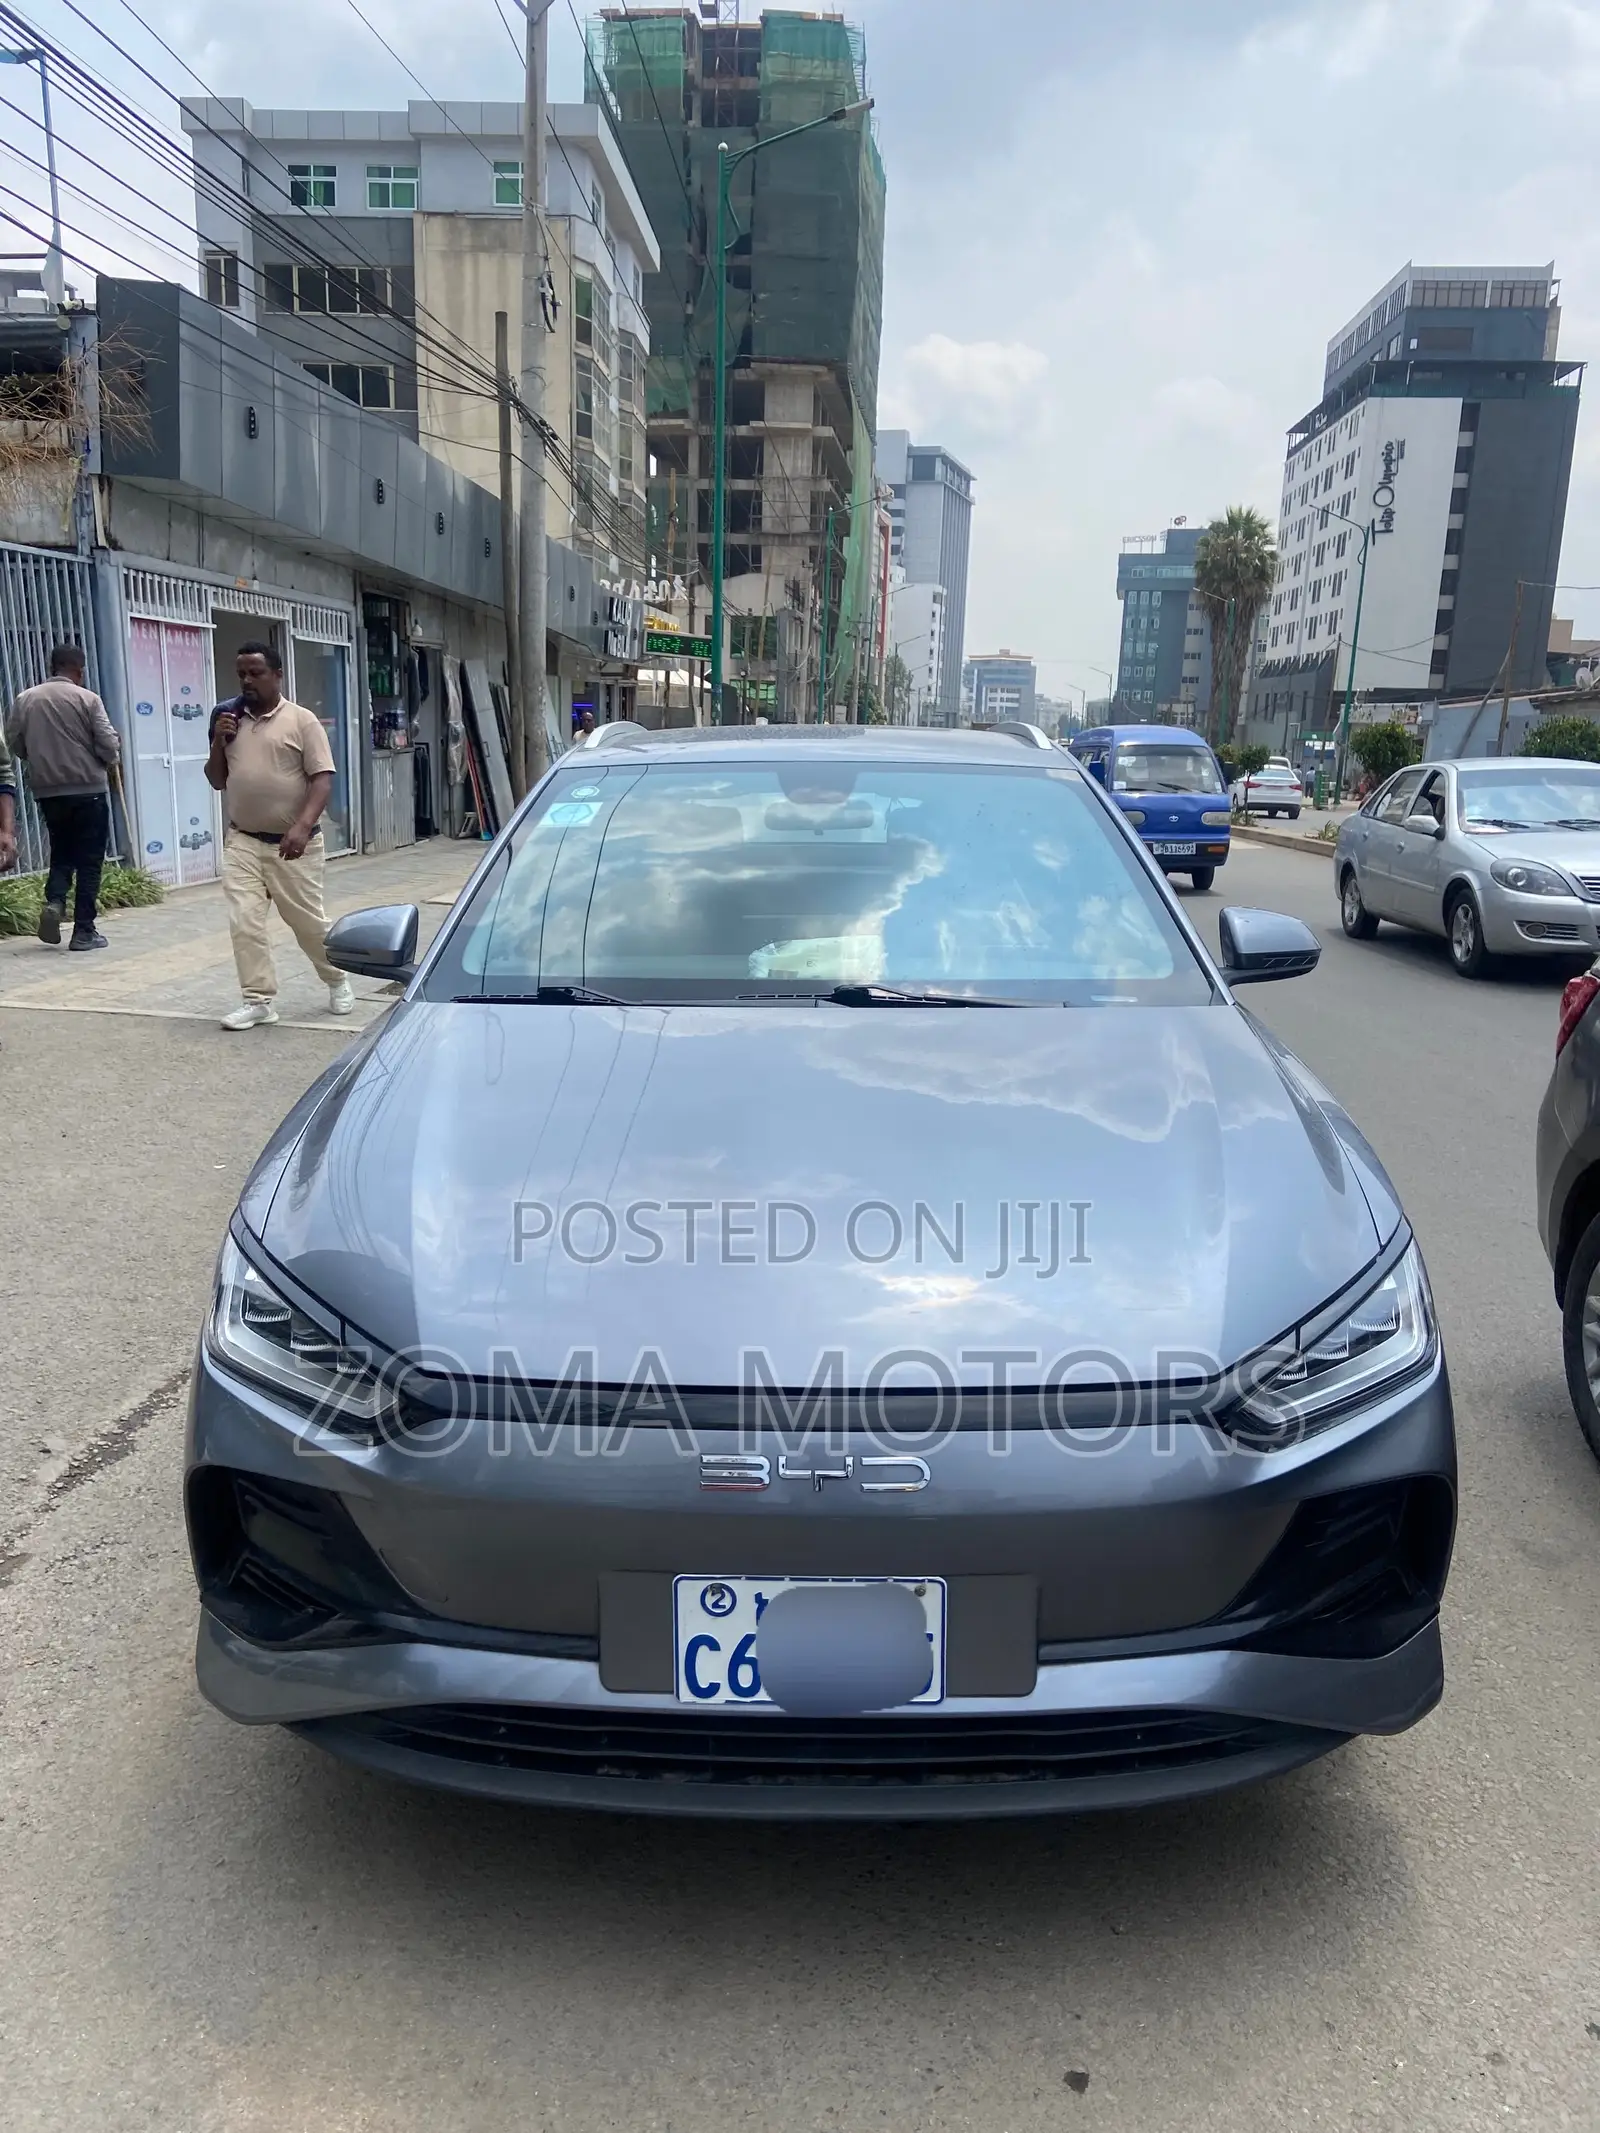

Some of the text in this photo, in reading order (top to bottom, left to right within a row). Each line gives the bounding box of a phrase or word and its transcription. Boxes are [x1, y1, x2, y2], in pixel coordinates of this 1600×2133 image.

[1373, 440, 1399, 507] Olympia
[1122, 535, 1157, 543] ERICSSON
[700, 1454, 932, 1492] BYD
